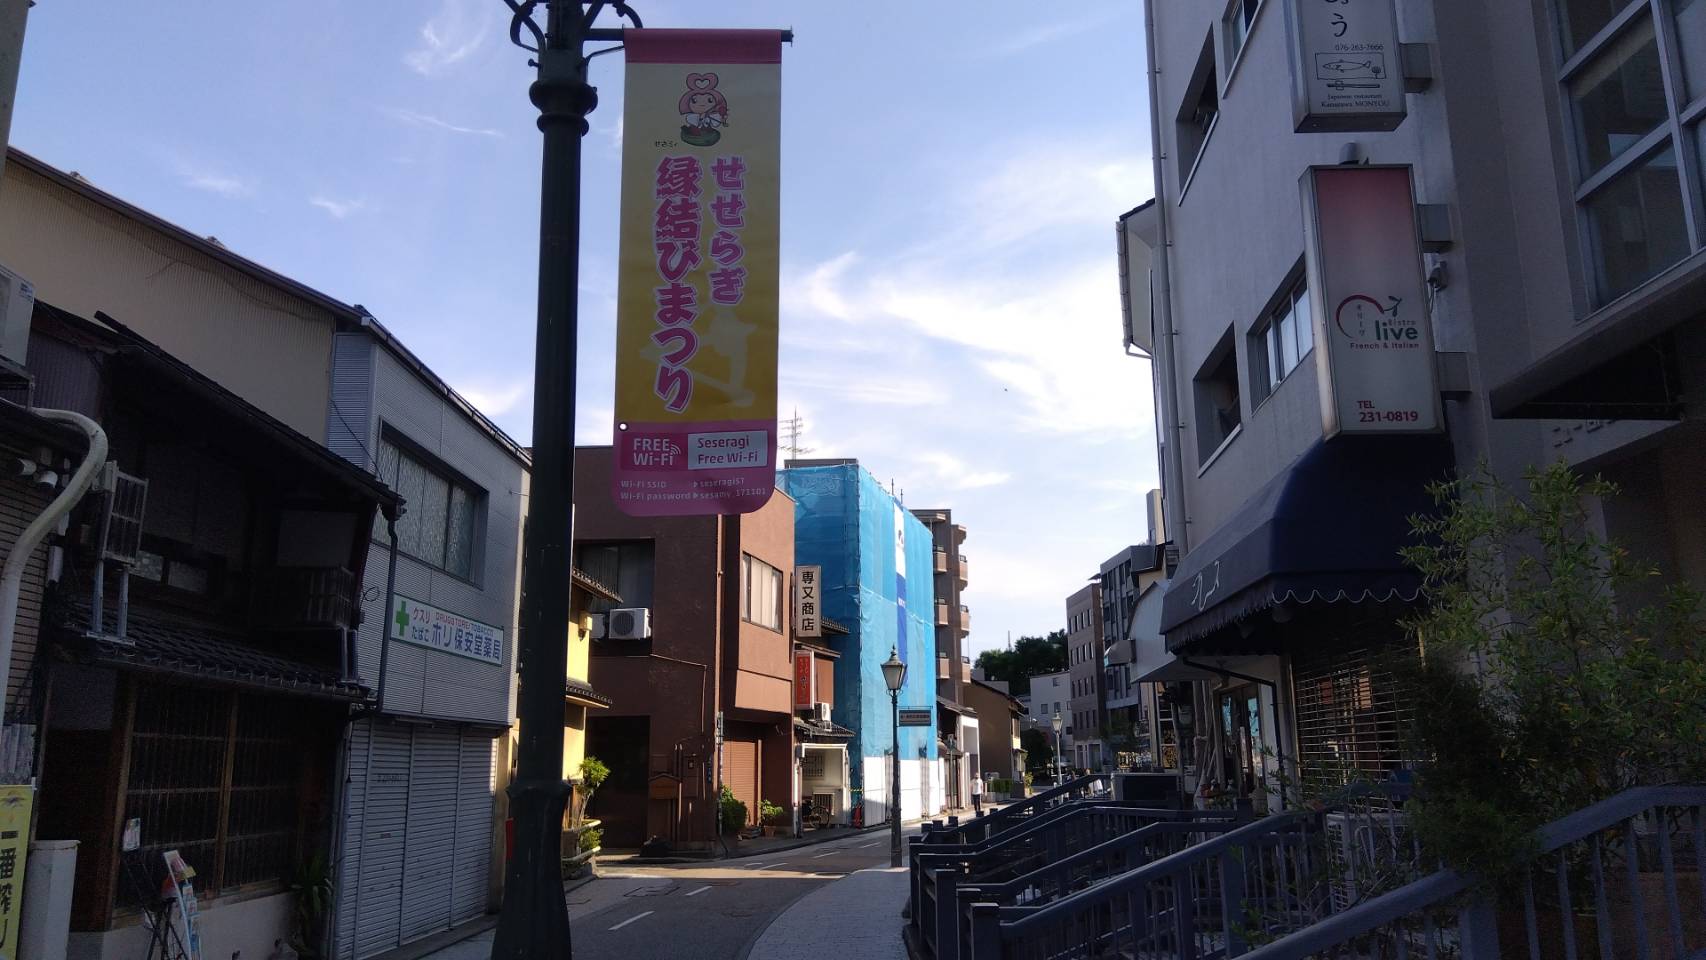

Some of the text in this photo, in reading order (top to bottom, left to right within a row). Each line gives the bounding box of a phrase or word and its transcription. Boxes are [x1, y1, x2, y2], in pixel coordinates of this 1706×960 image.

[709, 155, 747, 304] せせらぎ
[651, 155, 702, 413] 縁結びまつり
[1357, 400, 1375, 409] TEL
[1359, 411, 1418, 422] 231-0819
[633, 438, 670, 451] FREE
[698, 436, 750, 449] Seseragi
[633, 452, 673, 466] Wi-Fi
[698, 451, 758, 464] Free Wi-Fi
[620, 480, 644, 488] Wi-Fi
[620, 492, 644, 500] Wi-Fi
[647, 491, 691, 501] password
[801, 571, 815, 631] 専又商店
[412, 607, 431, 624] クスリ
[411, 625, 429, 641] たばこ
